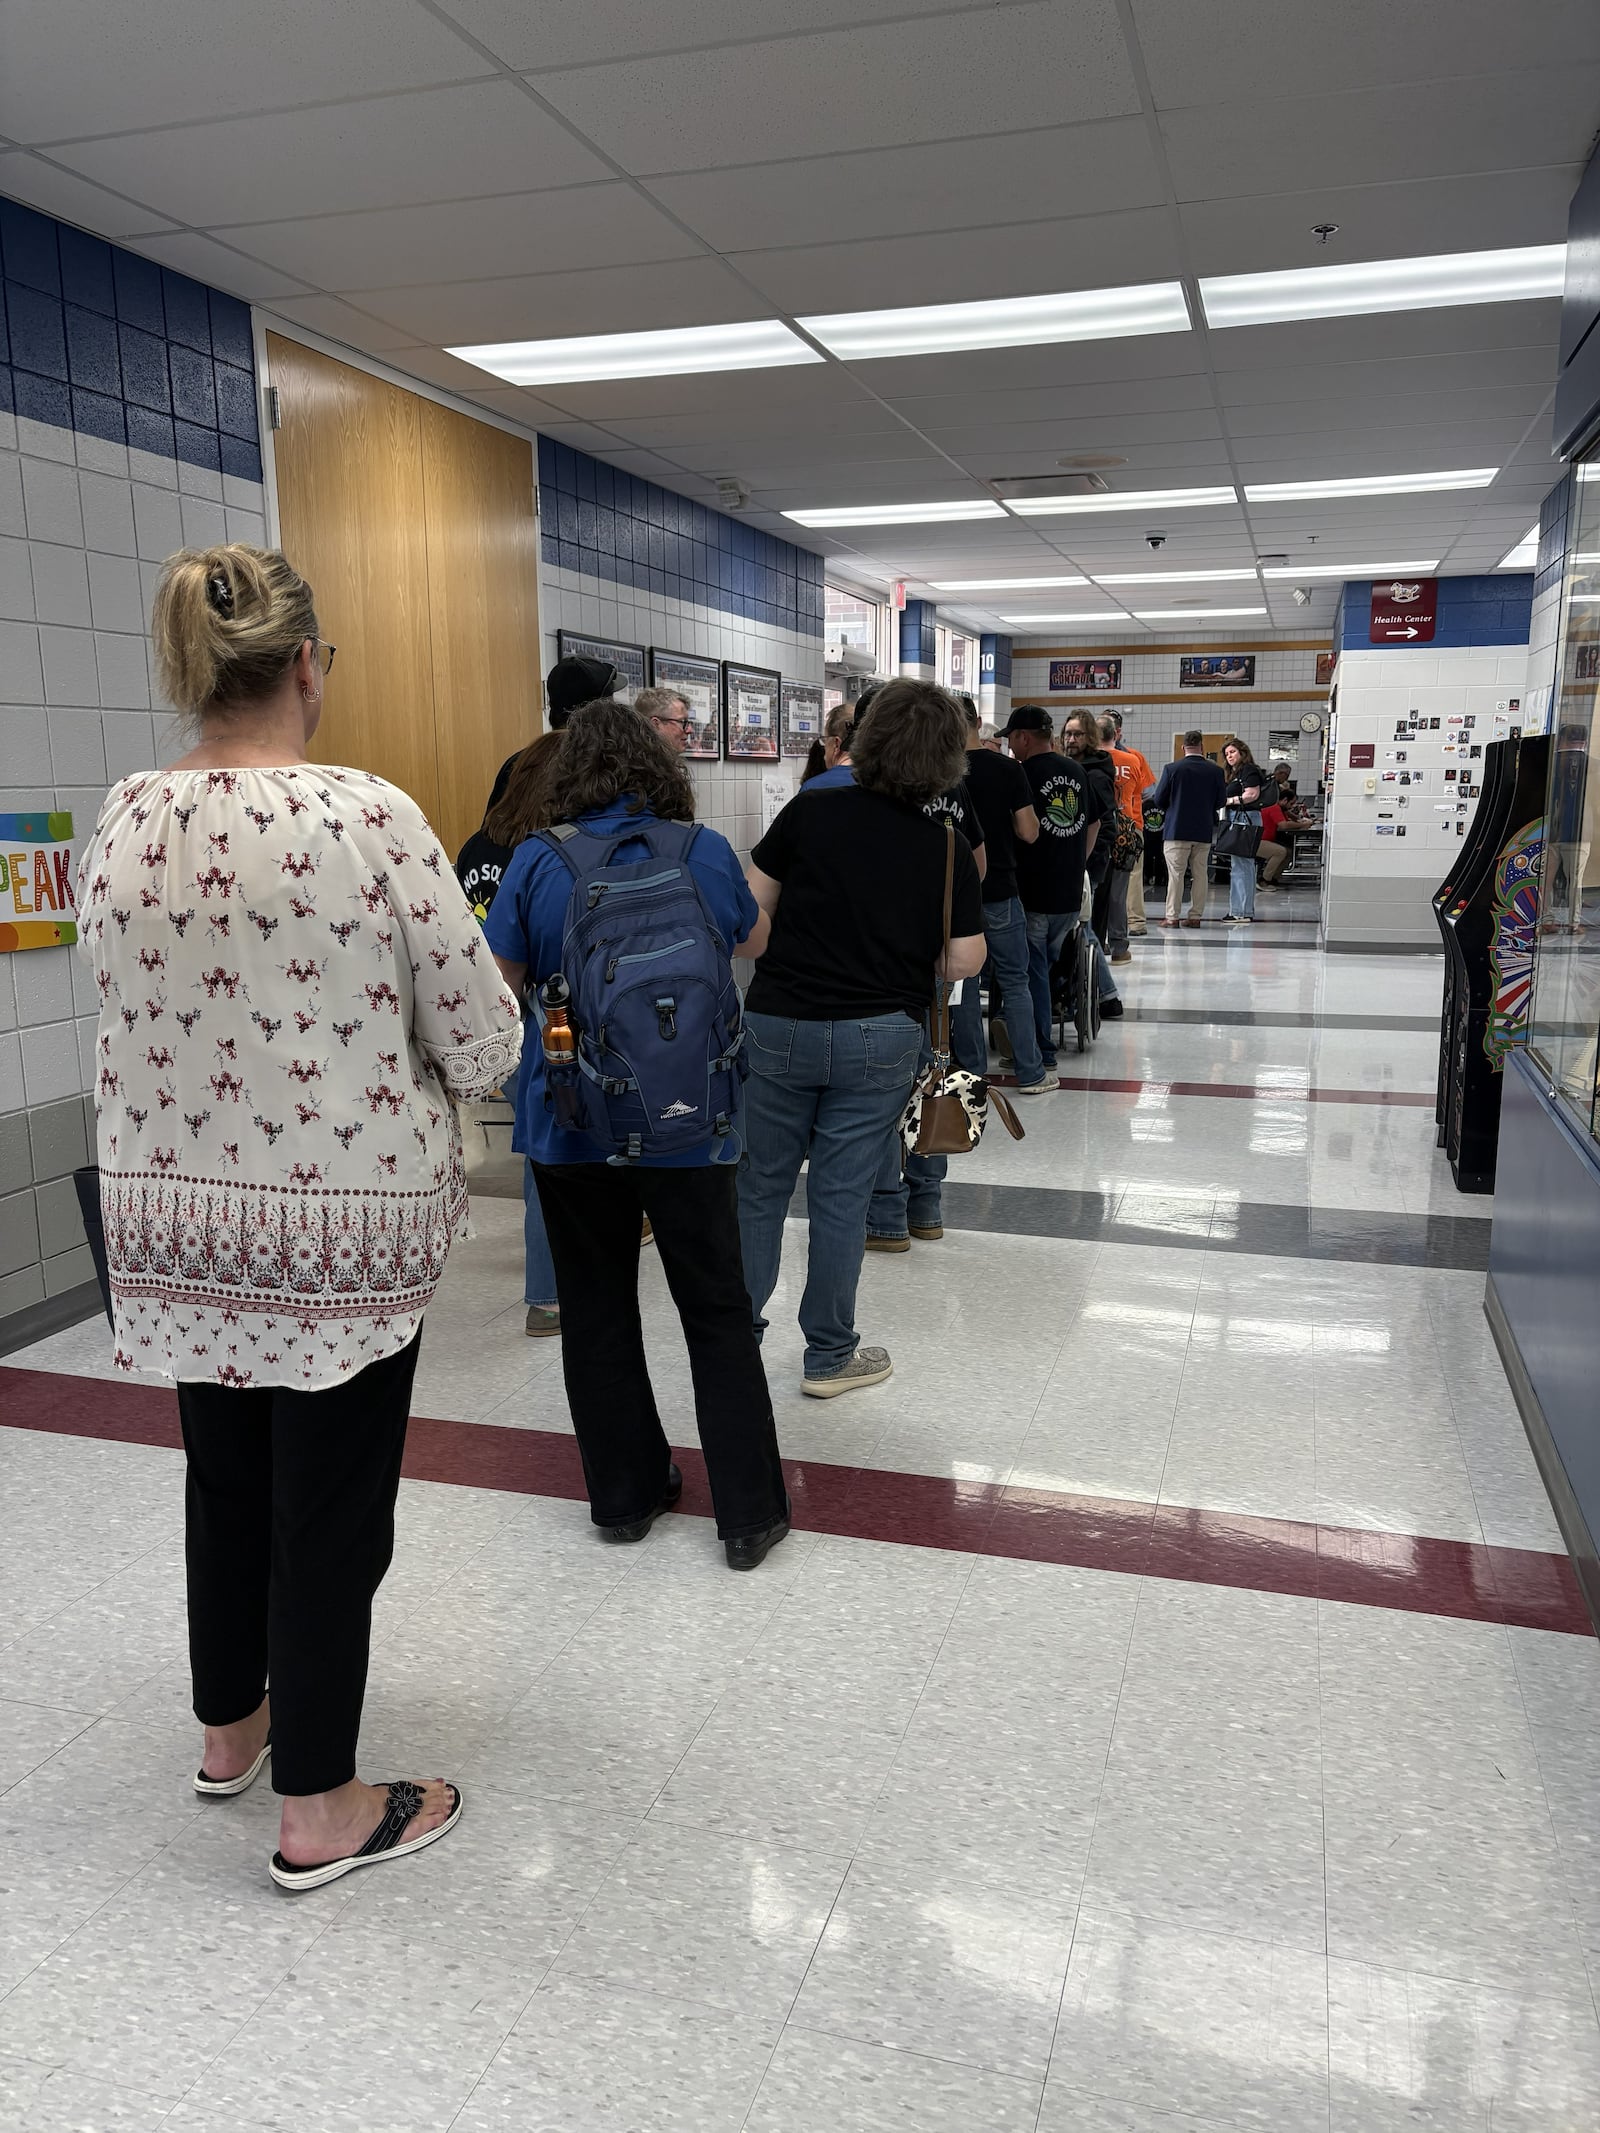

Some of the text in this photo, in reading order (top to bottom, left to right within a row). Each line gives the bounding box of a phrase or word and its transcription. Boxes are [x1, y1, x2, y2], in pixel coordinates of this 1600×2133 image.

[1374, 614, 1433, 624] Health Center
[1040, 775, 1082, 797] NO SOLAR
[931, 796, 965, 823] SOLAR
[1041, 816, 1053, 832] ON
[463, 868, 480, 895] NO
